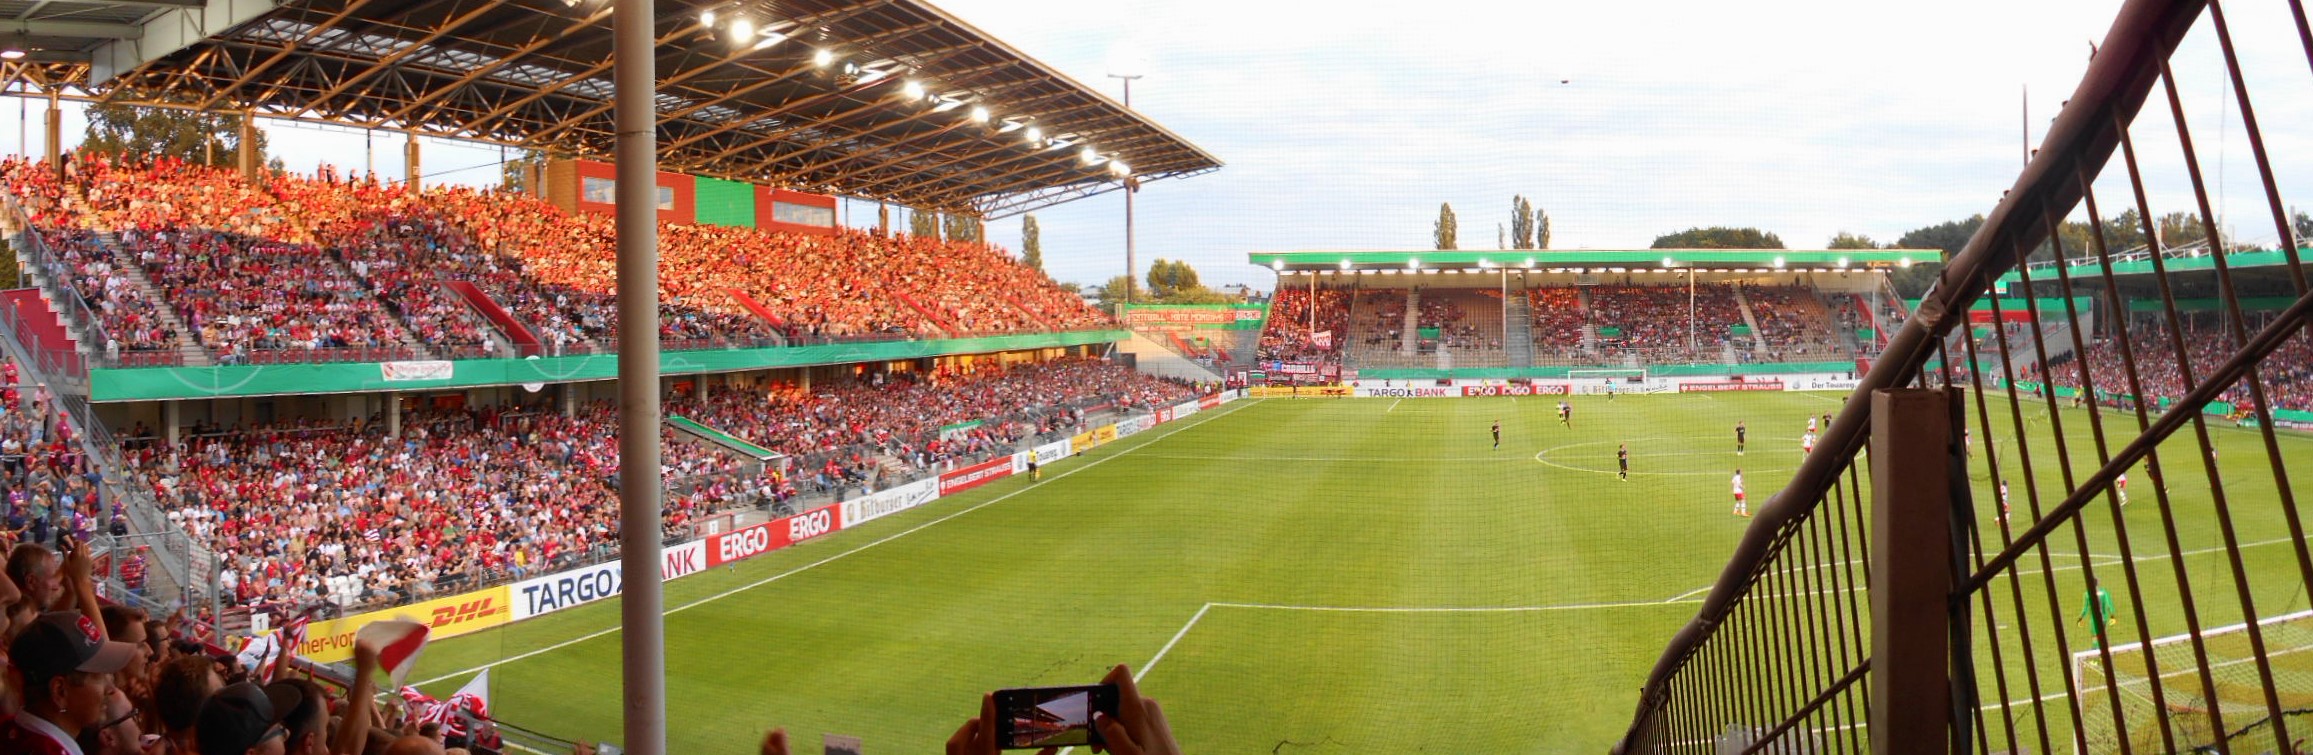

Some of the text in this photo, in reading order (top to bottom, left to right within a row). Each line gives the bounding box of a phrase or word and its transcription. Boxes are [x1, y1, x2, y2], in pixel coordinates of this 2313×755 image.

[1368, 387, 1446, 397] TARGO BANK
[1536, 385, 1564, 395] ERGO
[946, 470, 984, 489] ENGELBERT
[789, 508, 830, 540] ERGO
[720, 527, 768, 561] ERGO
[522, 569, 612, 615] TARGO
[431, 597, 498, 628] DHL
